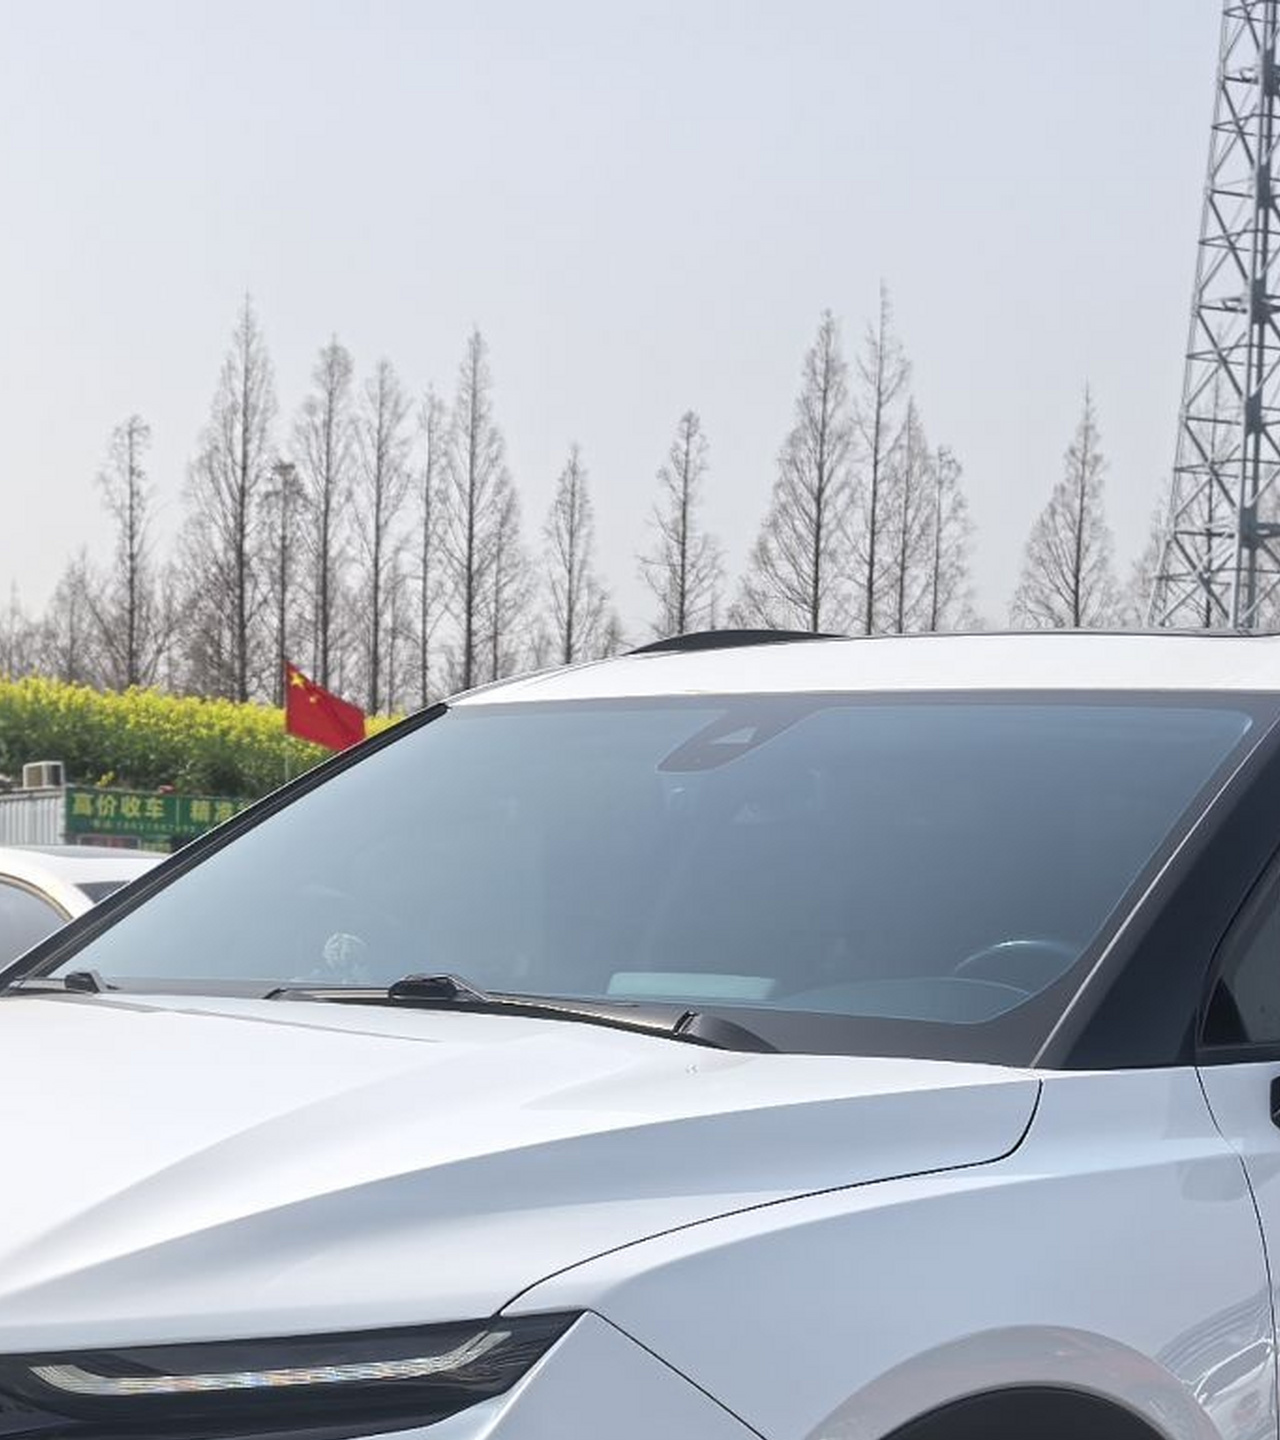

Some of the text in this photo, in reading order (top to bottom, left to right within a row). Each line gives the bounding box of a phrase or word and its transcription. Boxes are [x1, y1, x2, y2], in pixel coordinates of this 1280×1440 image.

[72, 792, 249, 823] 高价收车 精准
